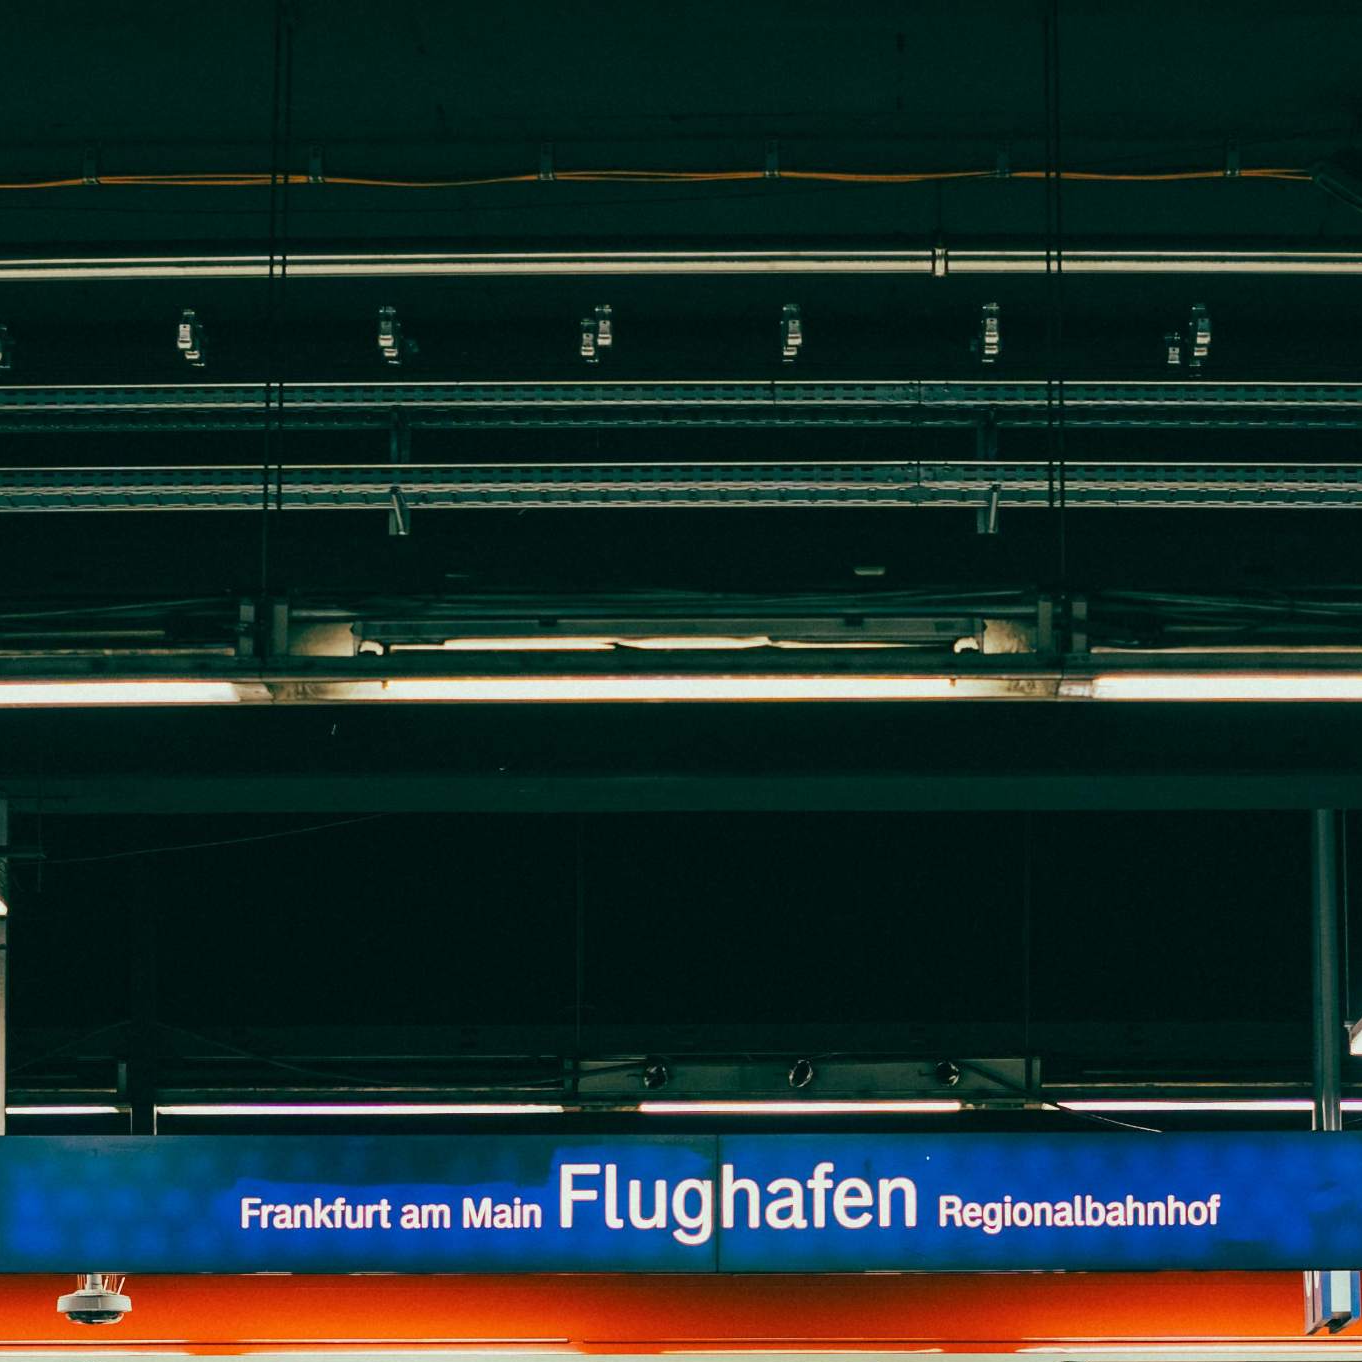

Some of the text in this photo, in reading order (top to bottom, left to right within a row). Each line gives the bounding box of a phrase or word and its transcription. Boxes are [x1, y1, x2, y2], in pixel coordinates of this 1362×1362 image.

[240, 1161, 1222, 1247] Frankfurt am Main Flughafen Regionalbahnhof
